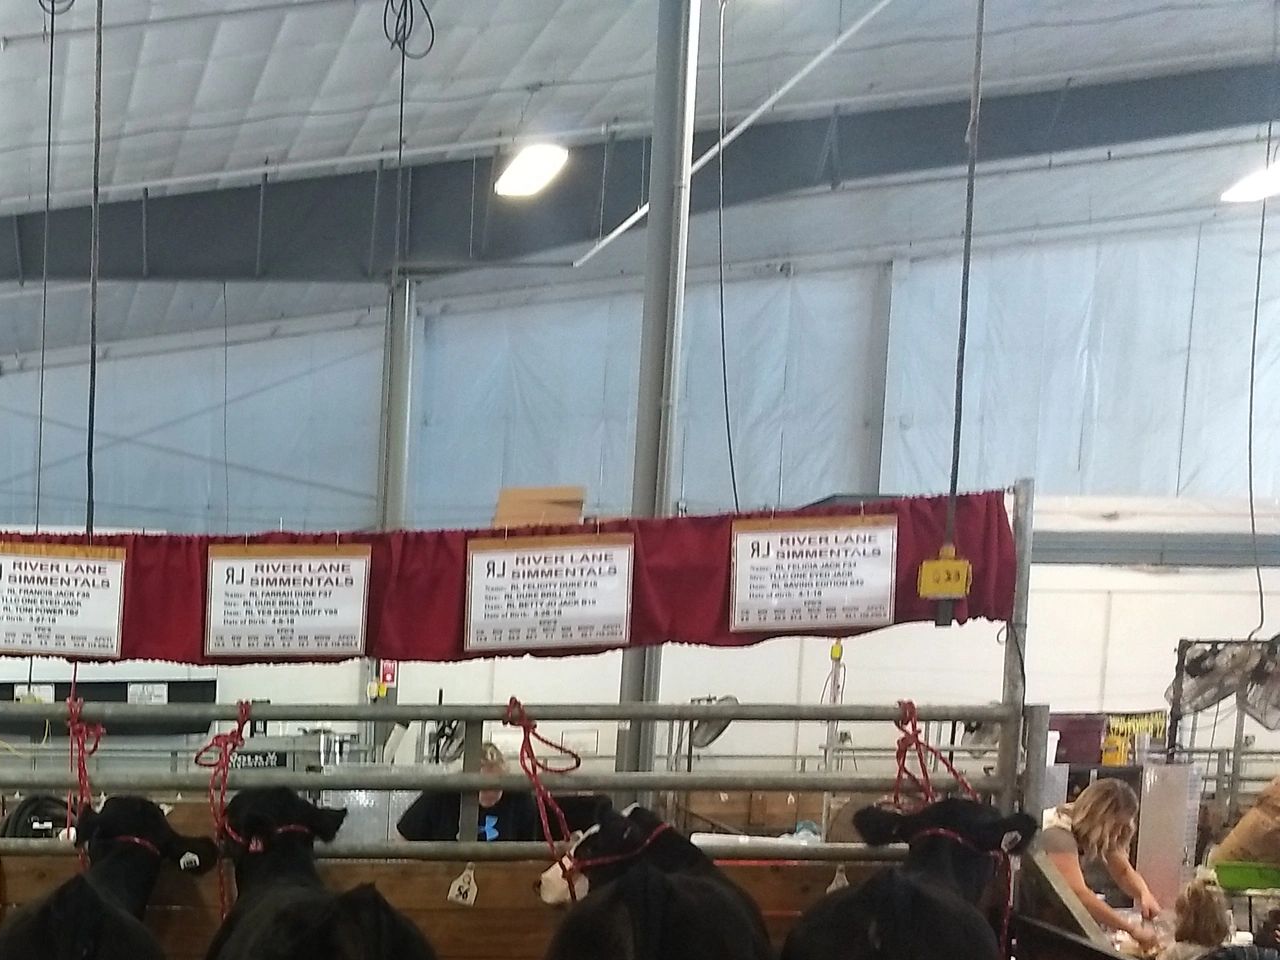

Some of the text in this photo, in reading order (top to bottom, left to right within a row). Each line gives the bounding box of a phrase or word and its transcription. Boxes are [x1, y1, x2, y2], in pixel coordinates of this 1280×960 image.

[780, 535, 877, 546] RIVER LANE
[776, 547, 881, 559] SIMMENTALS
[516, 553, 614, 566] RIVER LANE
[13, 562, 107, 574] RIVER LANE
[255, 564, 351, 573] RIVER LANE
[512, 566, 617, 580] SIMMENTALS
[8, 575, 110, 589] SIMMENTALS
[251, 577, 354, 587] SIMMENTALS
